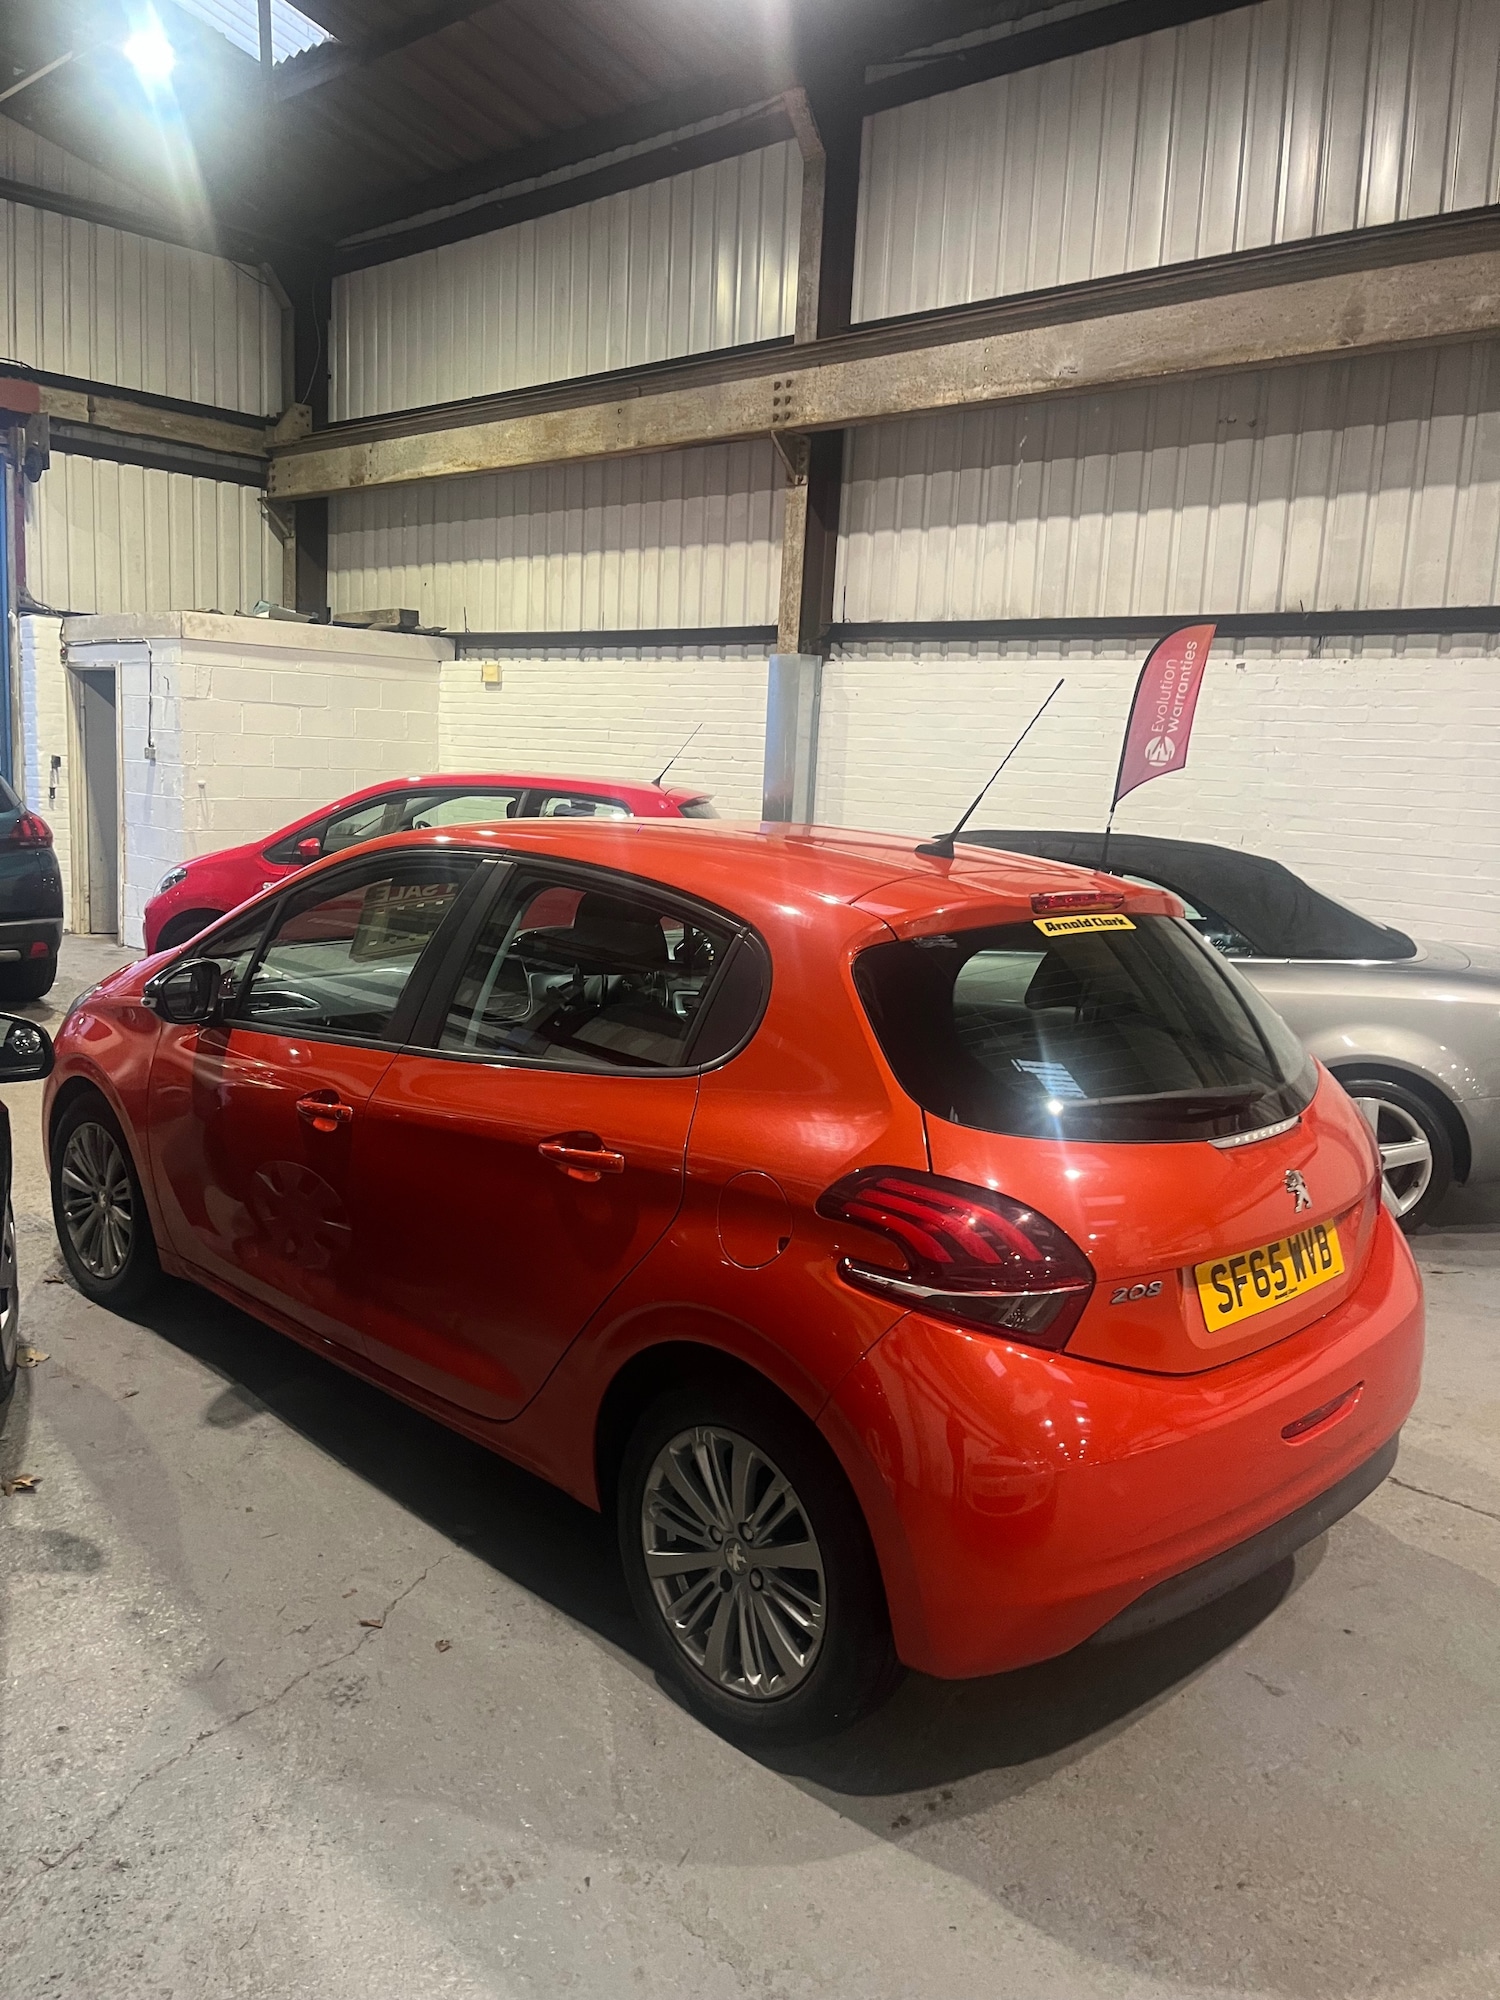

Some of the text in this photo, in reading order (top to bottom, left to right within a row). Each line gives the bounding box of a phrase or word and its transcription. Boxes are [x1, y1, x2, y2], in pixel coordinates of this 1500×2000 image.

[1151, 659, 1178, 733] Evolution
[1166, 640, 1198, 734] Warranties
[1044, 916, 1128, 932] Arnold Clark
[1234, 1122, 1287, 1145] PEUGEOT
[1110, 1280, 1163, 1304] 208
[1210, 1224, 1332, 1314] SF65 WVB
